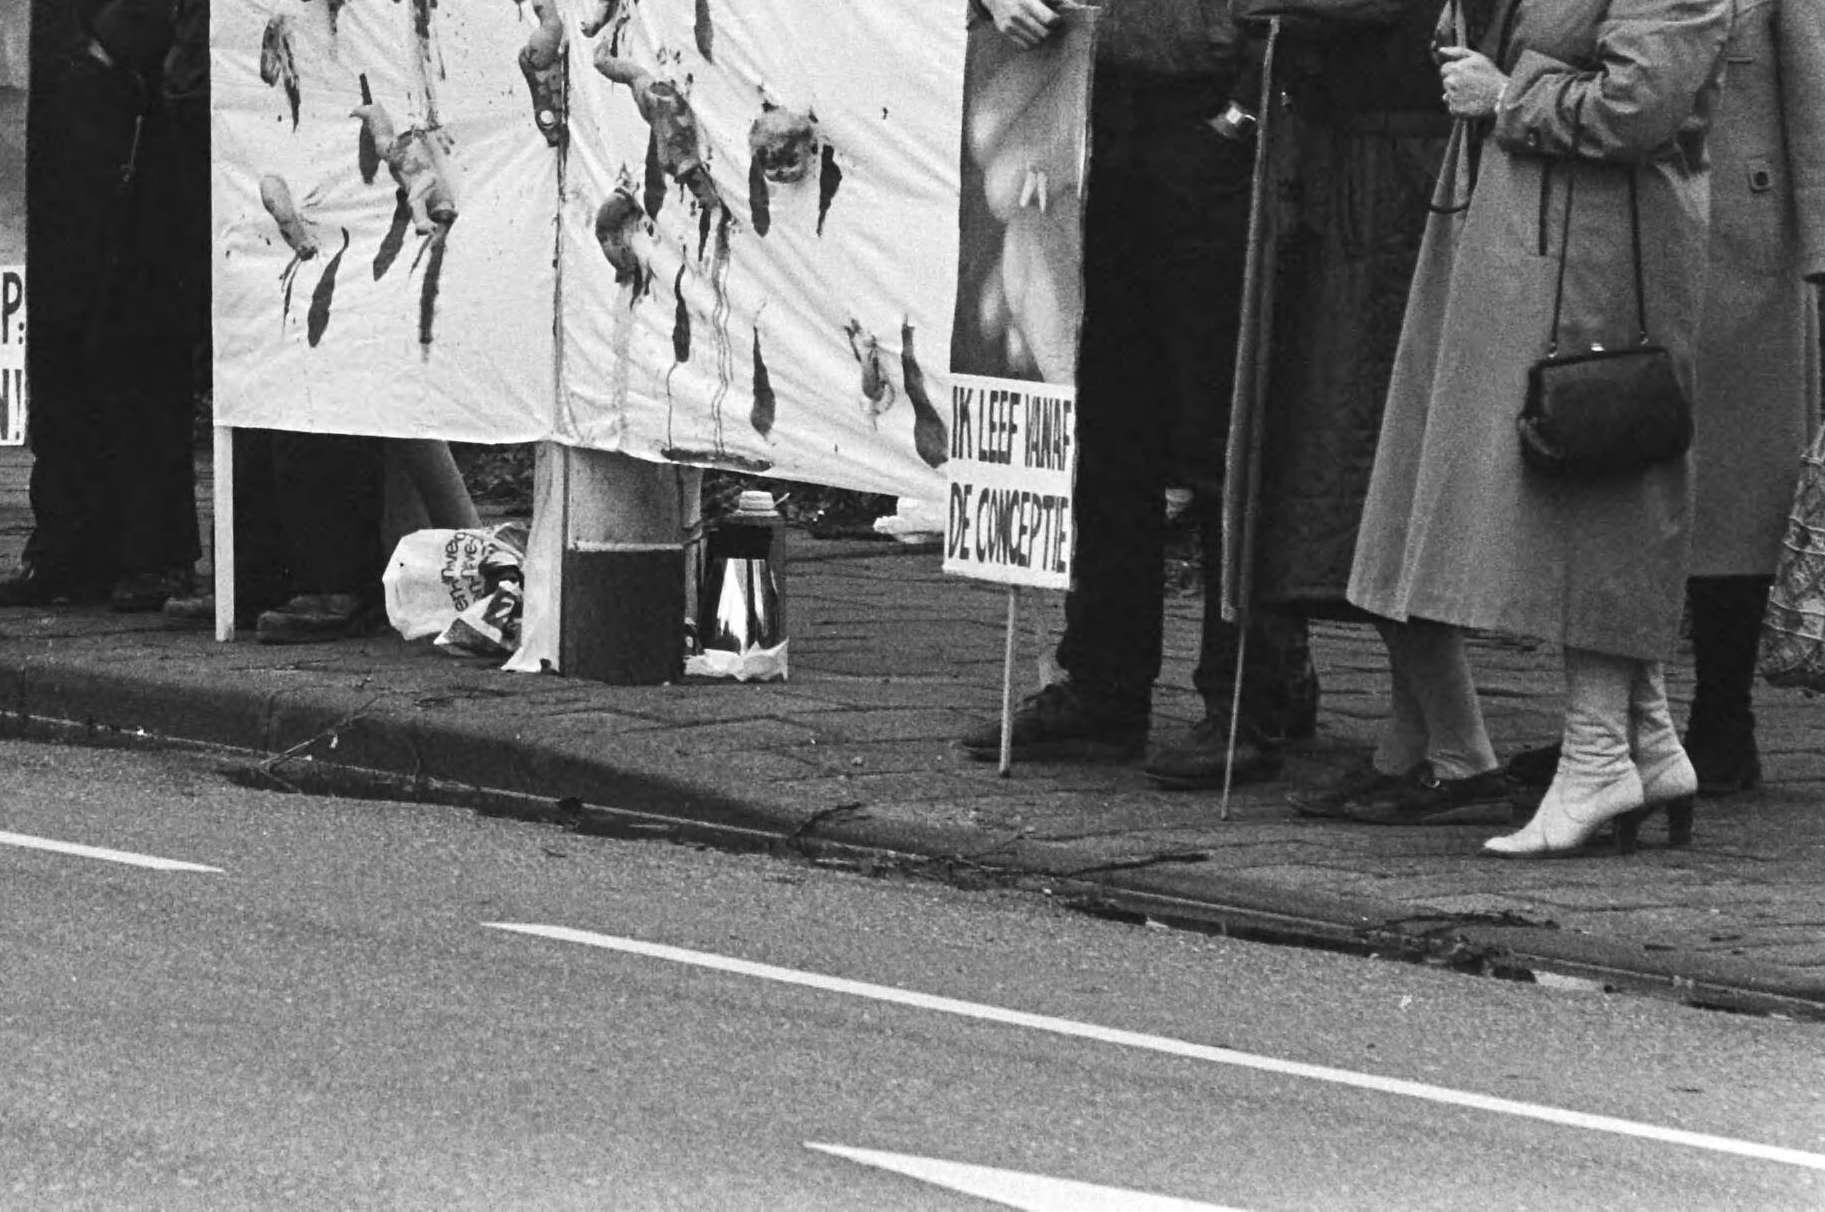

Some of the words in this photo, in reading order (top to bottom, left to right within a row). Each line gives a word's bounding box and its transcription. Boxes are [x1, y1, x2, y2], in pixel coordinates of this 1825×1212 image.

[951, 385, 974, 460] IK
[978, 389, 1022, 466] LEEF
[948, 481, 973, 561] DE
[975, 487, 1069, 574] CONCEPTIE
